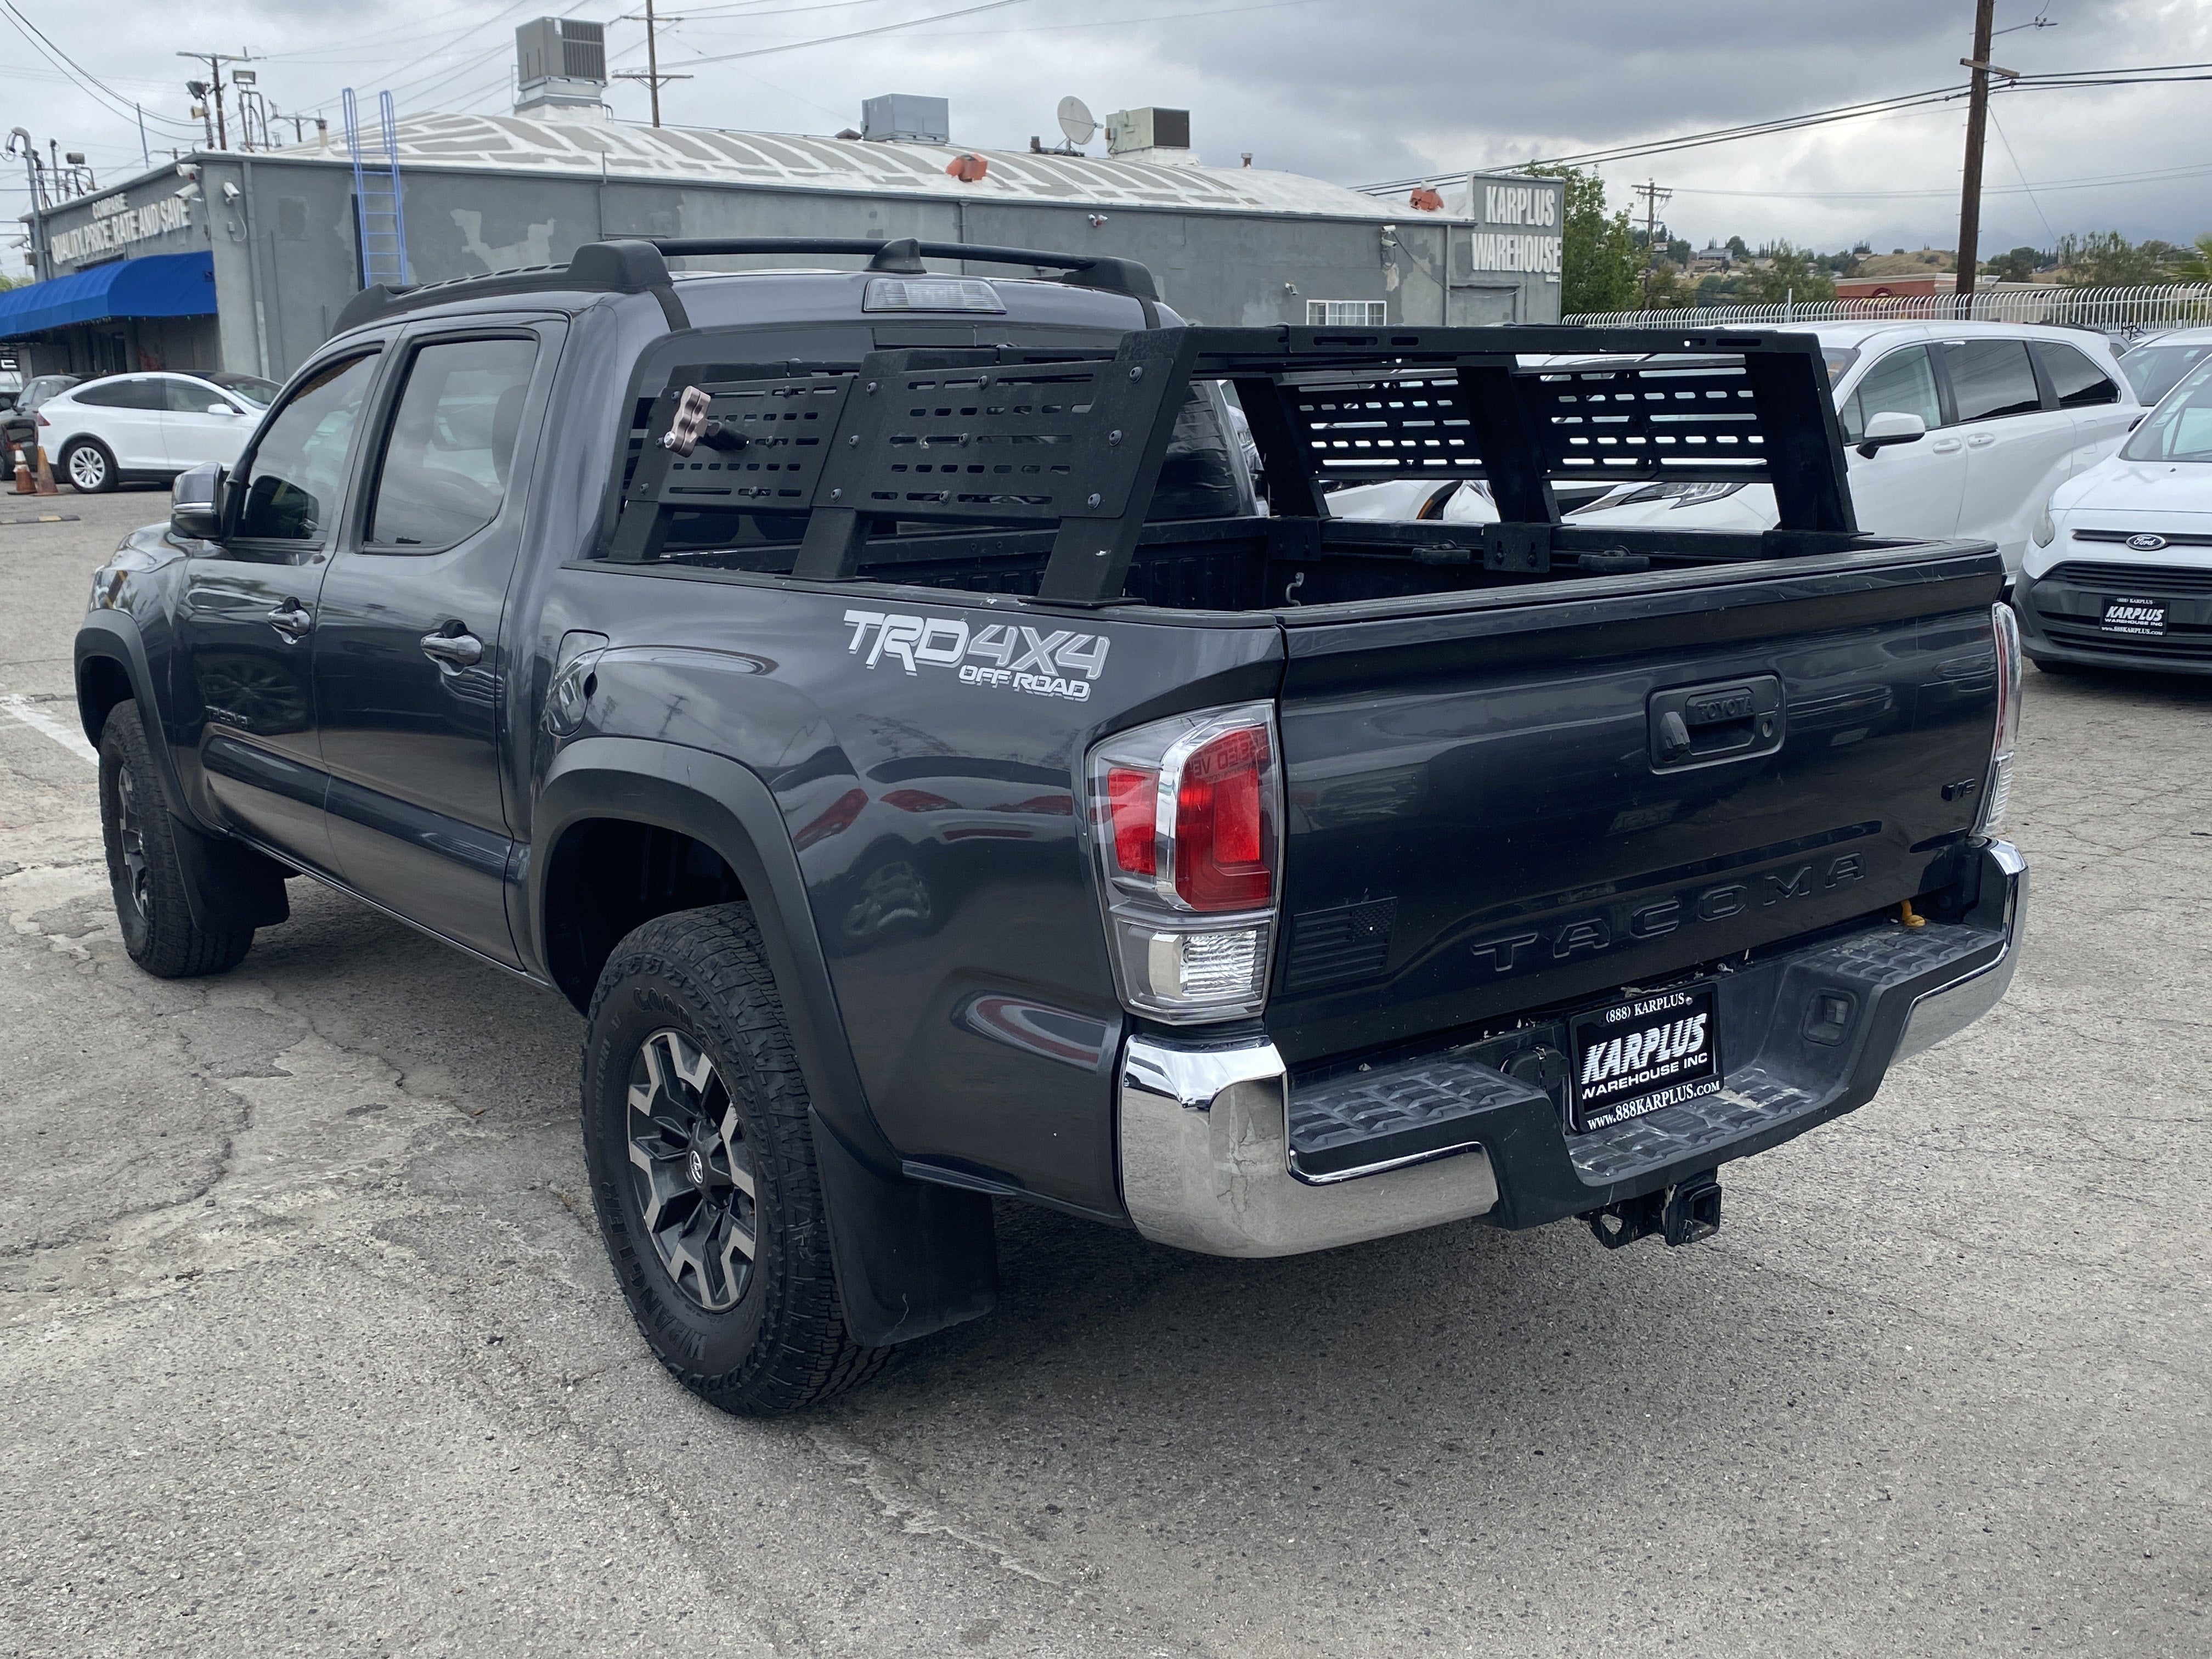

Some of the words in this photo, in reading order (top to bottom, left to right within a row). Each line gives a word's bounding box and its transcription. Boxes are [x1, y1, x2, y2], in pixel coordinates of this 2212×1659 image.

[111, 210, 138, 245] RATE
[139, 204, 160, 238] AND
[160, 197, 191, 233] SAVE
[1485, 186, 1555, 226] KARPLUS
[1471, 233, 1561, 273] WAREHOUSE
[2134, 536, 2155, 546] Ford
[2106, 606, 2164, 621] KARPLUS
[843, 610, 969, 676] TRD
[959, 665, 1012, 688] OFF
[1013, 672, 1091, 702] ROAD
[1697, 696, 1753, 721] TOYOTA
[1470, 850, 1865, 972] TACOMA
[1606, 1007, 1631, 1023] (888)
[1634, 992, 1685, 1017] KARPLUS
[1581, 1013, 1707, 1085] KARPLUS
[1582, 1061, 1679, 1099] WAREHOUSE
[1683, 1052, 1708, 1069] INC
[602, 1181, 709, 1362] WRANGLER
